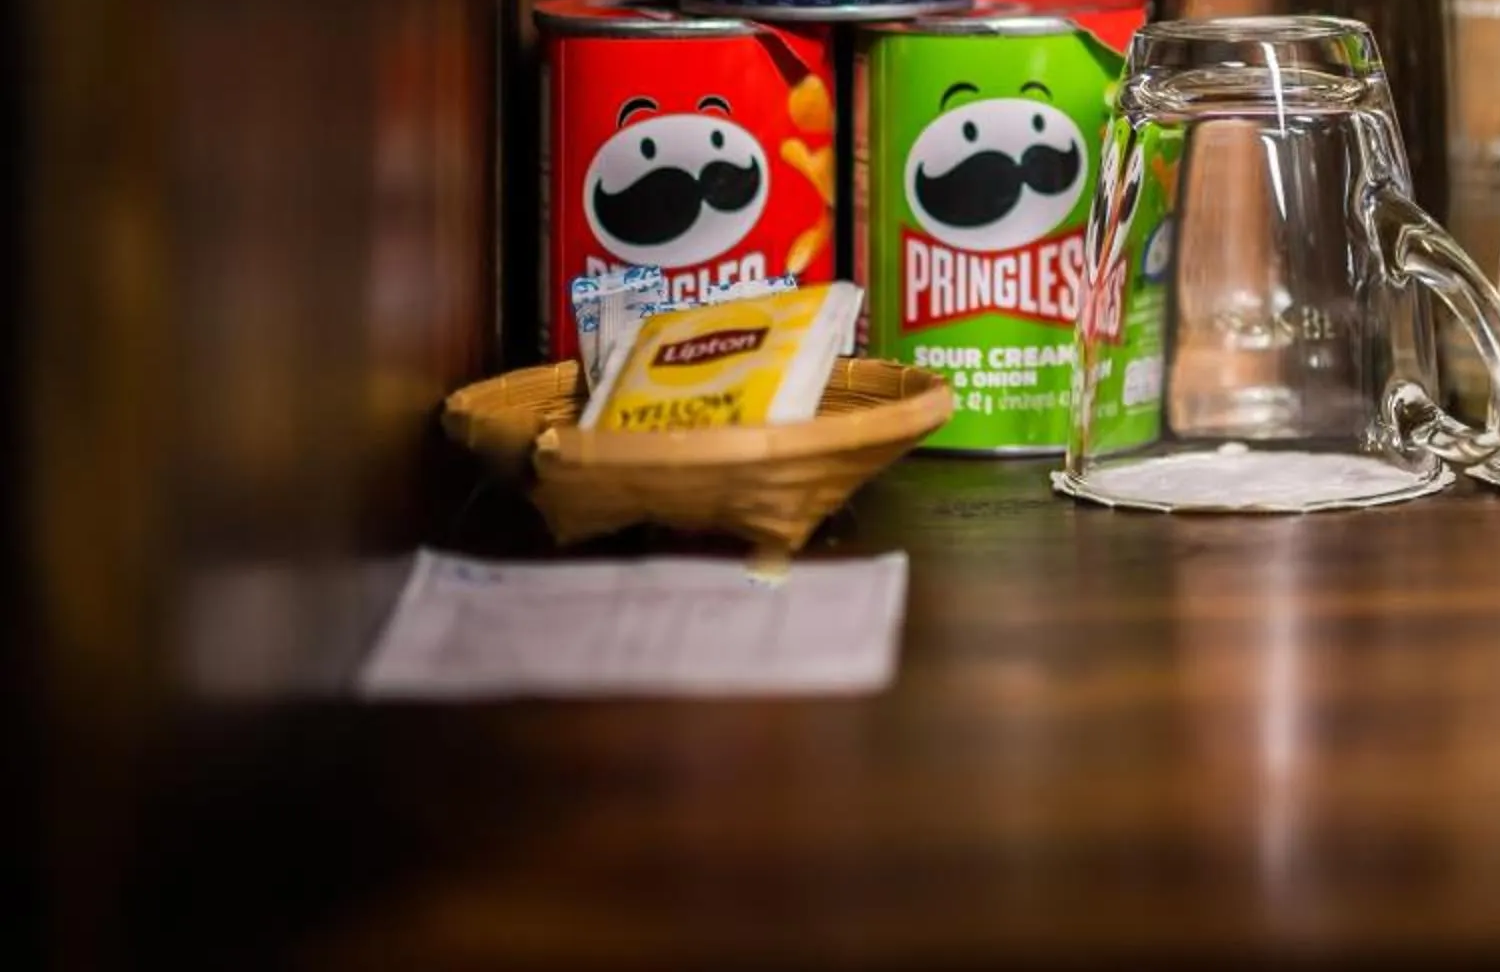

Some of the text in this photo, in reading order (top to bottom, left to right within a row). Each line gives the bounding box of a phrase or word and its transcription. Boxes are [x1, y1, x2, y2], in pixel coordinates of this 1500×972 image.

[905, 234, 1085, 323] PRINGLES
[663, 331, 757, 365] Lipton
[913, 345, 1078, 370] SOUR CREAM
[972, 370, 1038, 388] ONION
